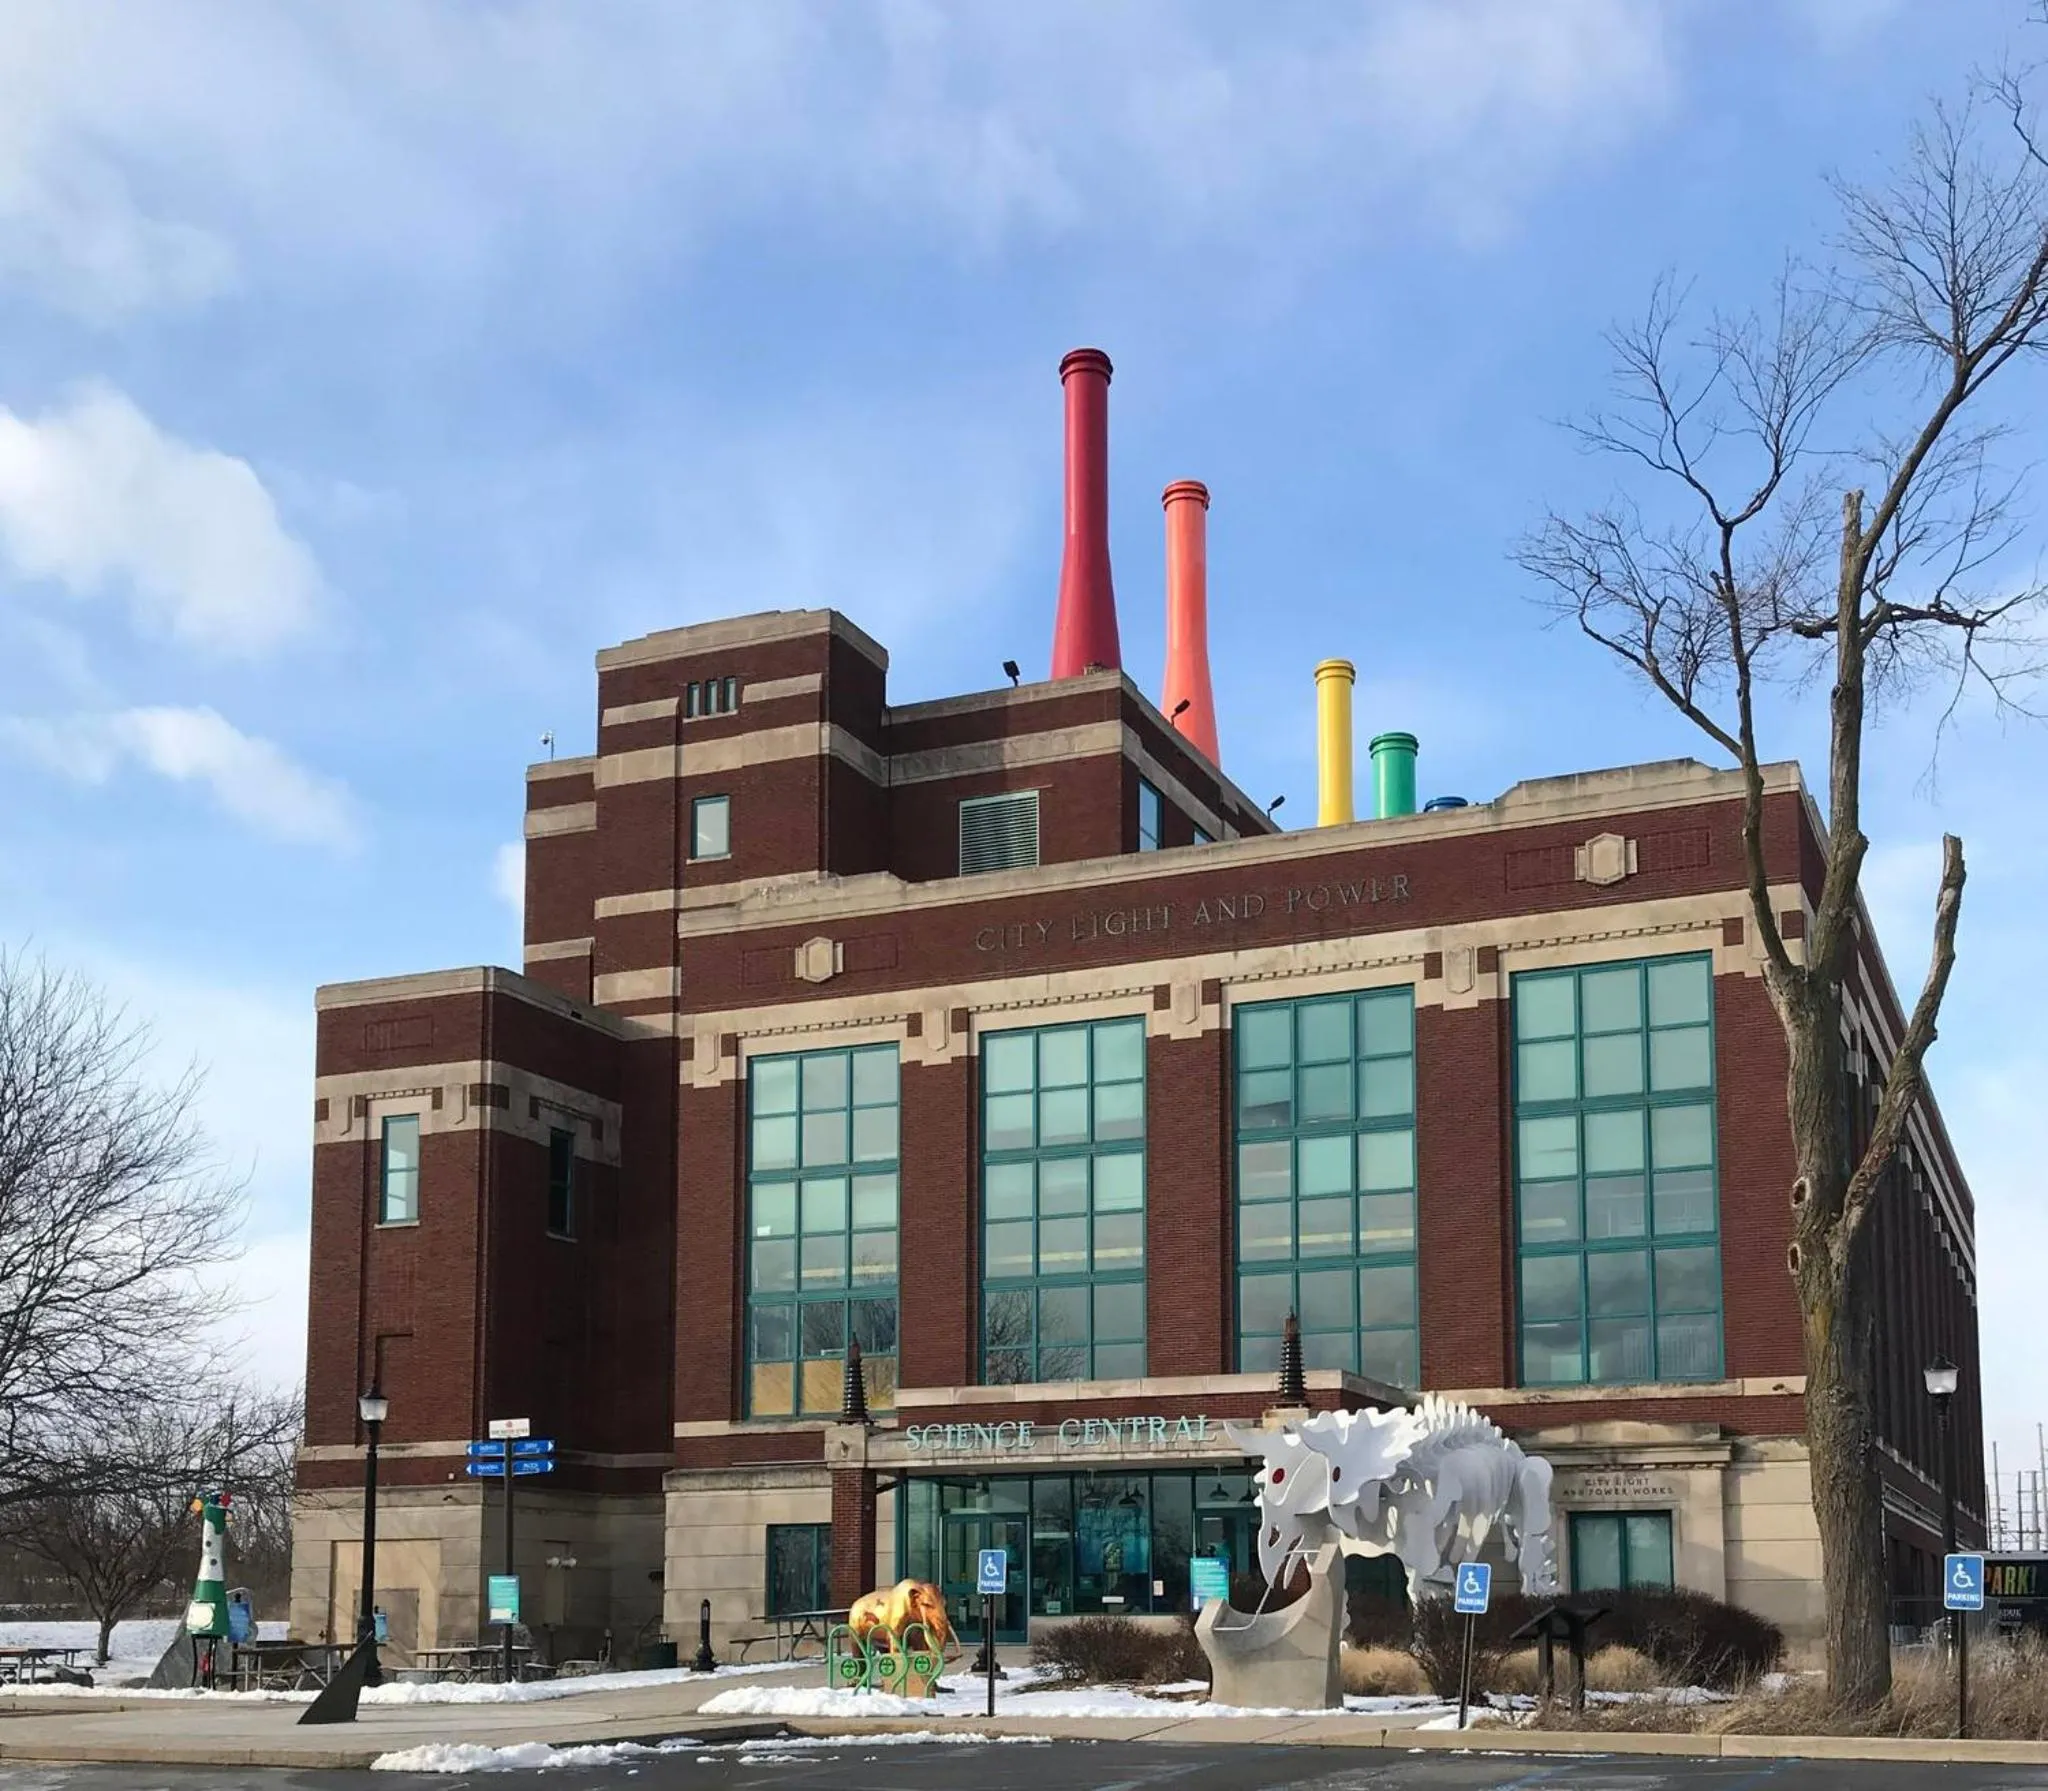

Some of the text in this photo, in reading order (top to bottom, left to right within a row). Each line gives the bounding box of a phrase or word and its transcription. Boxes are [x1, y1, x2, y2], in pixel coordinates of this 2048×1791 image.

[975, 874, 1410, 951] CITY LIGHT AND POWER
[905, 1413, 1217, 1451] SCIENCE CENTRAL
[1584, 1478, 1610, 1487] CITY
[1588, 1486, 1629, 1497] POWER
[1632, 1486, 1675, 1496] WORKS
[1947, 1592, 1980, 1602] PARKING
